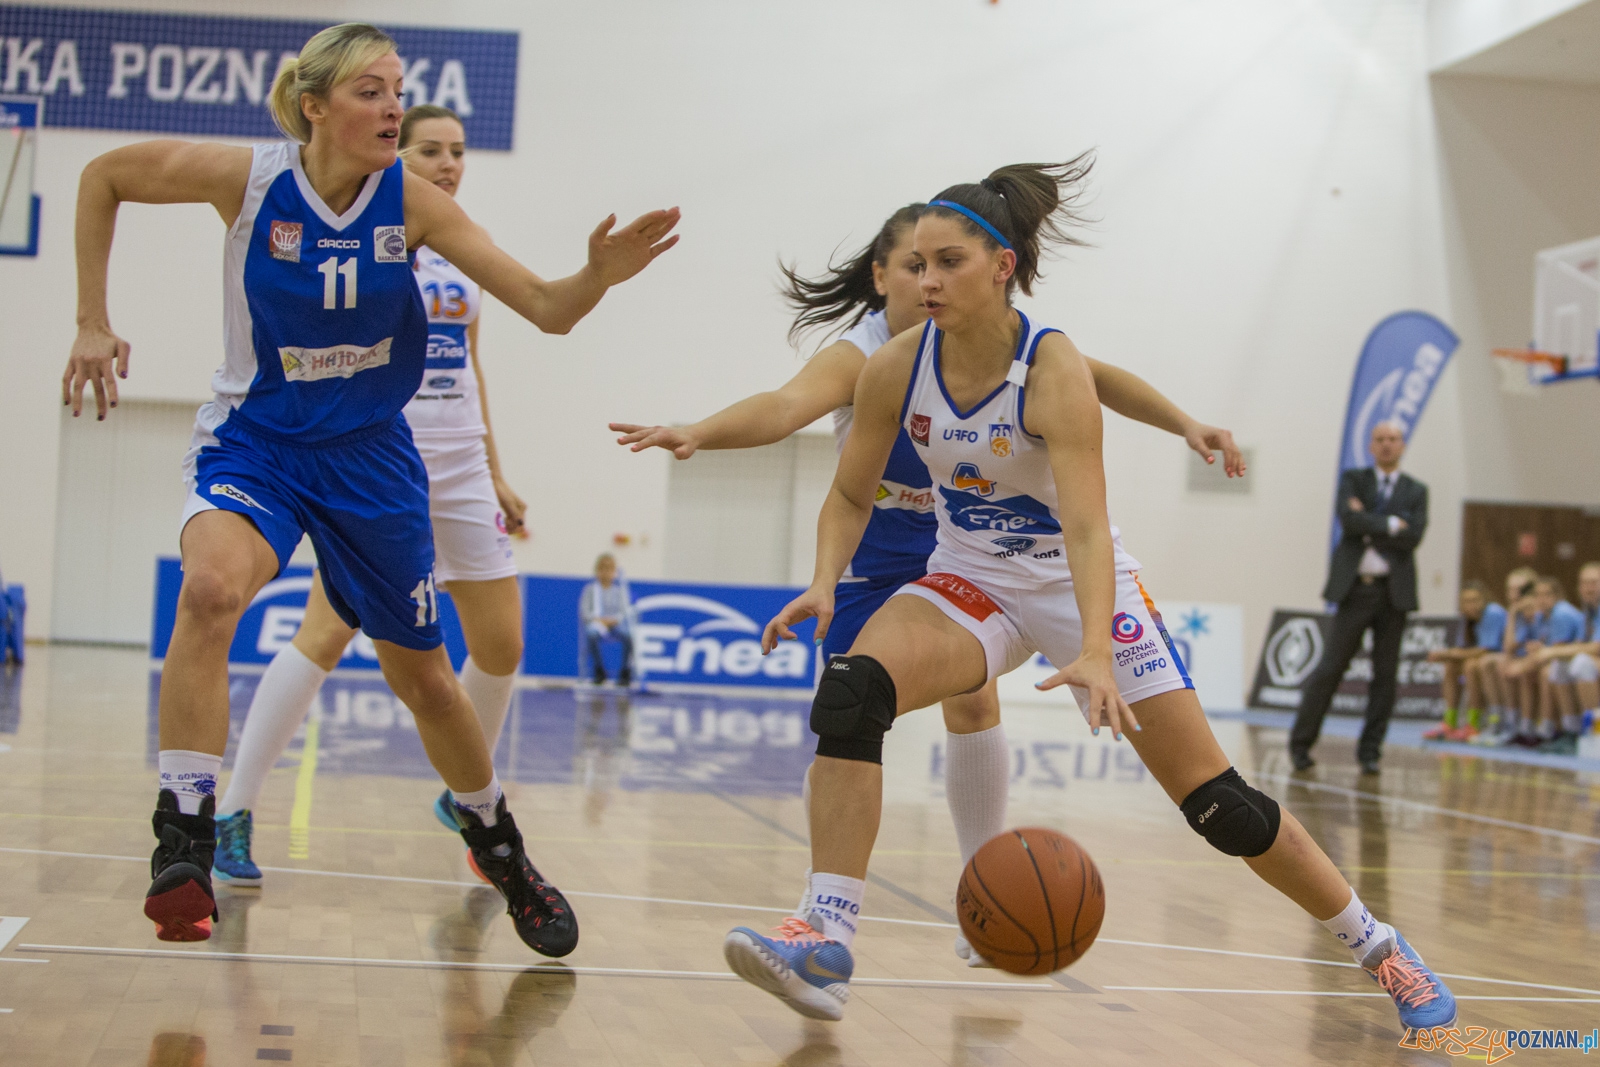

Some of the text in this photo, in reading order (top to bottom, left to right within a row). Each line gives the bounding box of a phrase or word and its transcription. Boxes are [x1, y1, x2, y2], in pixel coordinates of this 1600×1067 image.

[0, 37, 85, 97] KA
[317, 256, 358, 310] 11
[422, 280, 468, 318] 13
[410, 571, 438, 627] 11
[633, 624, 809, 679] Enea
[1115, 639, 1157, 661] POZNAŃ
[1118, 648, 1159, 667] CITY CENTER
